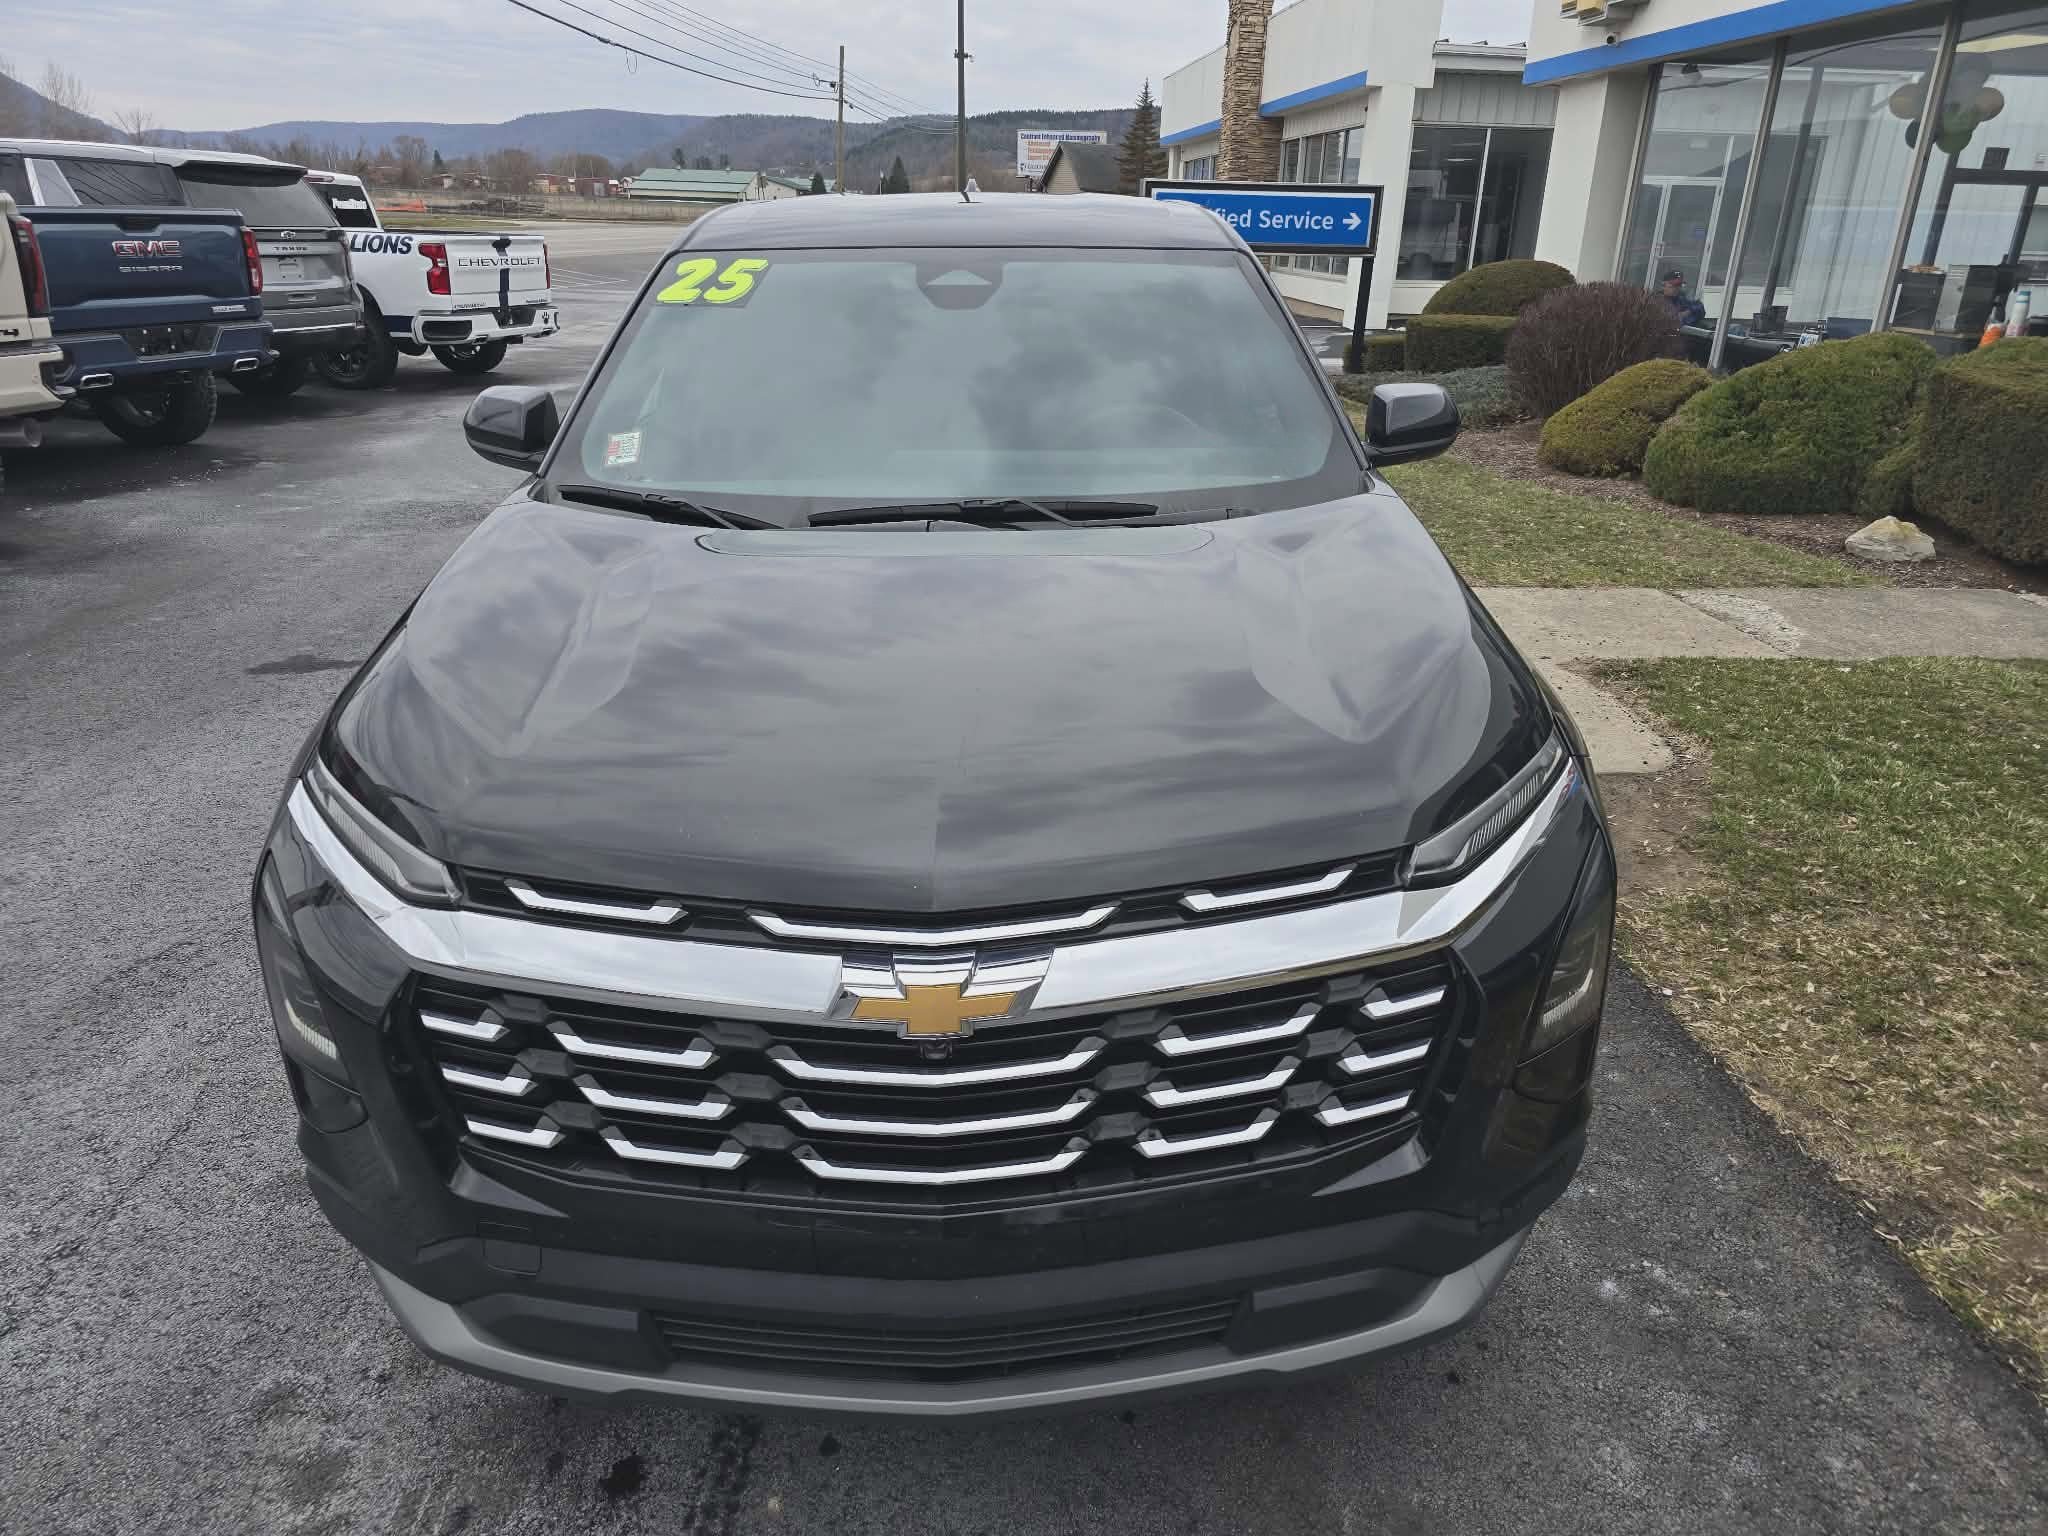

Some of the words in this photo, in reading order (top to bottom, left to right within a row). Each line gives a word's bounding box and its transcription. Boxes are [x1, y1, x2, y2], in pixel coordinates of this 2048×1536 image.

[1214, 208, 1252, 228] fied
[1258, 209, 1334, 230] Service
[112, 240, 183, 257] GMC
[351, 233, 414, 255] LIONS
[119, 265, 184, 273] SIERRA
[458, 256, 541, 267] CHEVROLET
[656, 258, 768, 304] 25
